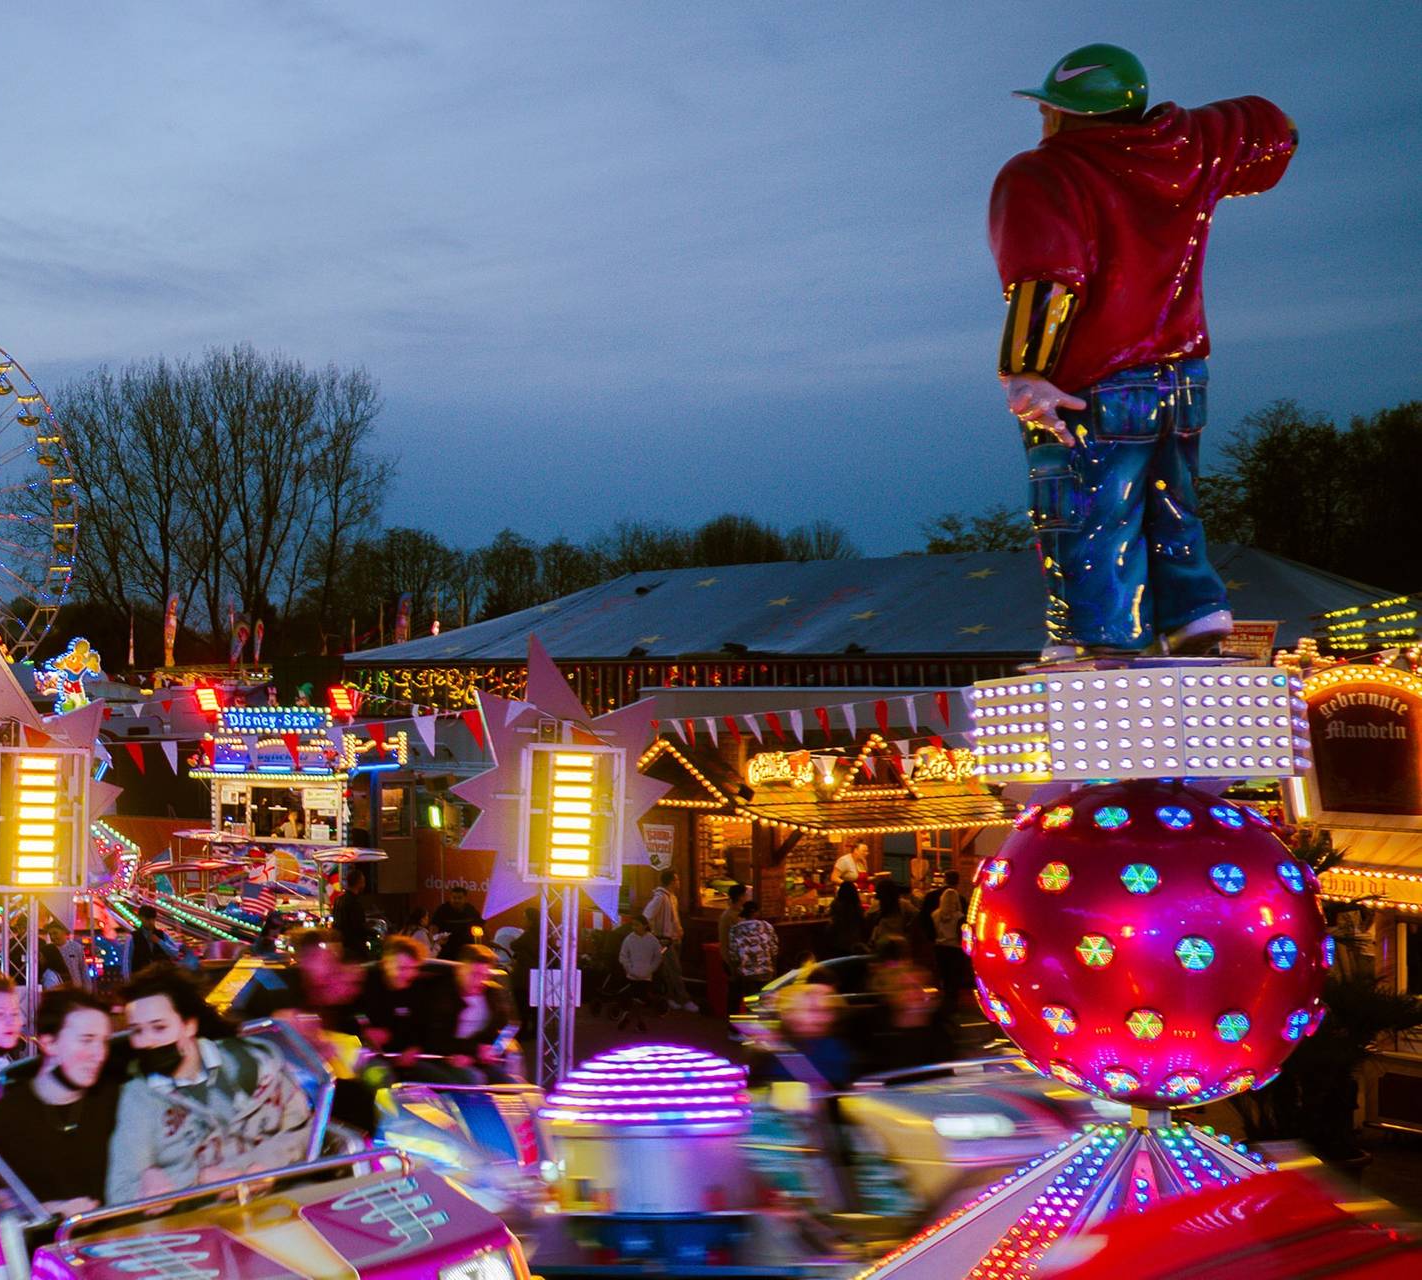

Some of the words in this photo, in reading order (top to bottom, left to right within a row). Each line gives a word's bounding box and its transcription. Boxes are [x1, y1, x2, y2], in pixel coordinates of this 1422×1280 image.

[1318, 691, 1408, 719] gebrannte
[284, 712, 318, 726] Star
[1324, 719, 1407, 740] Mandeln
[425, 875, 490, 893] dovoba.d
